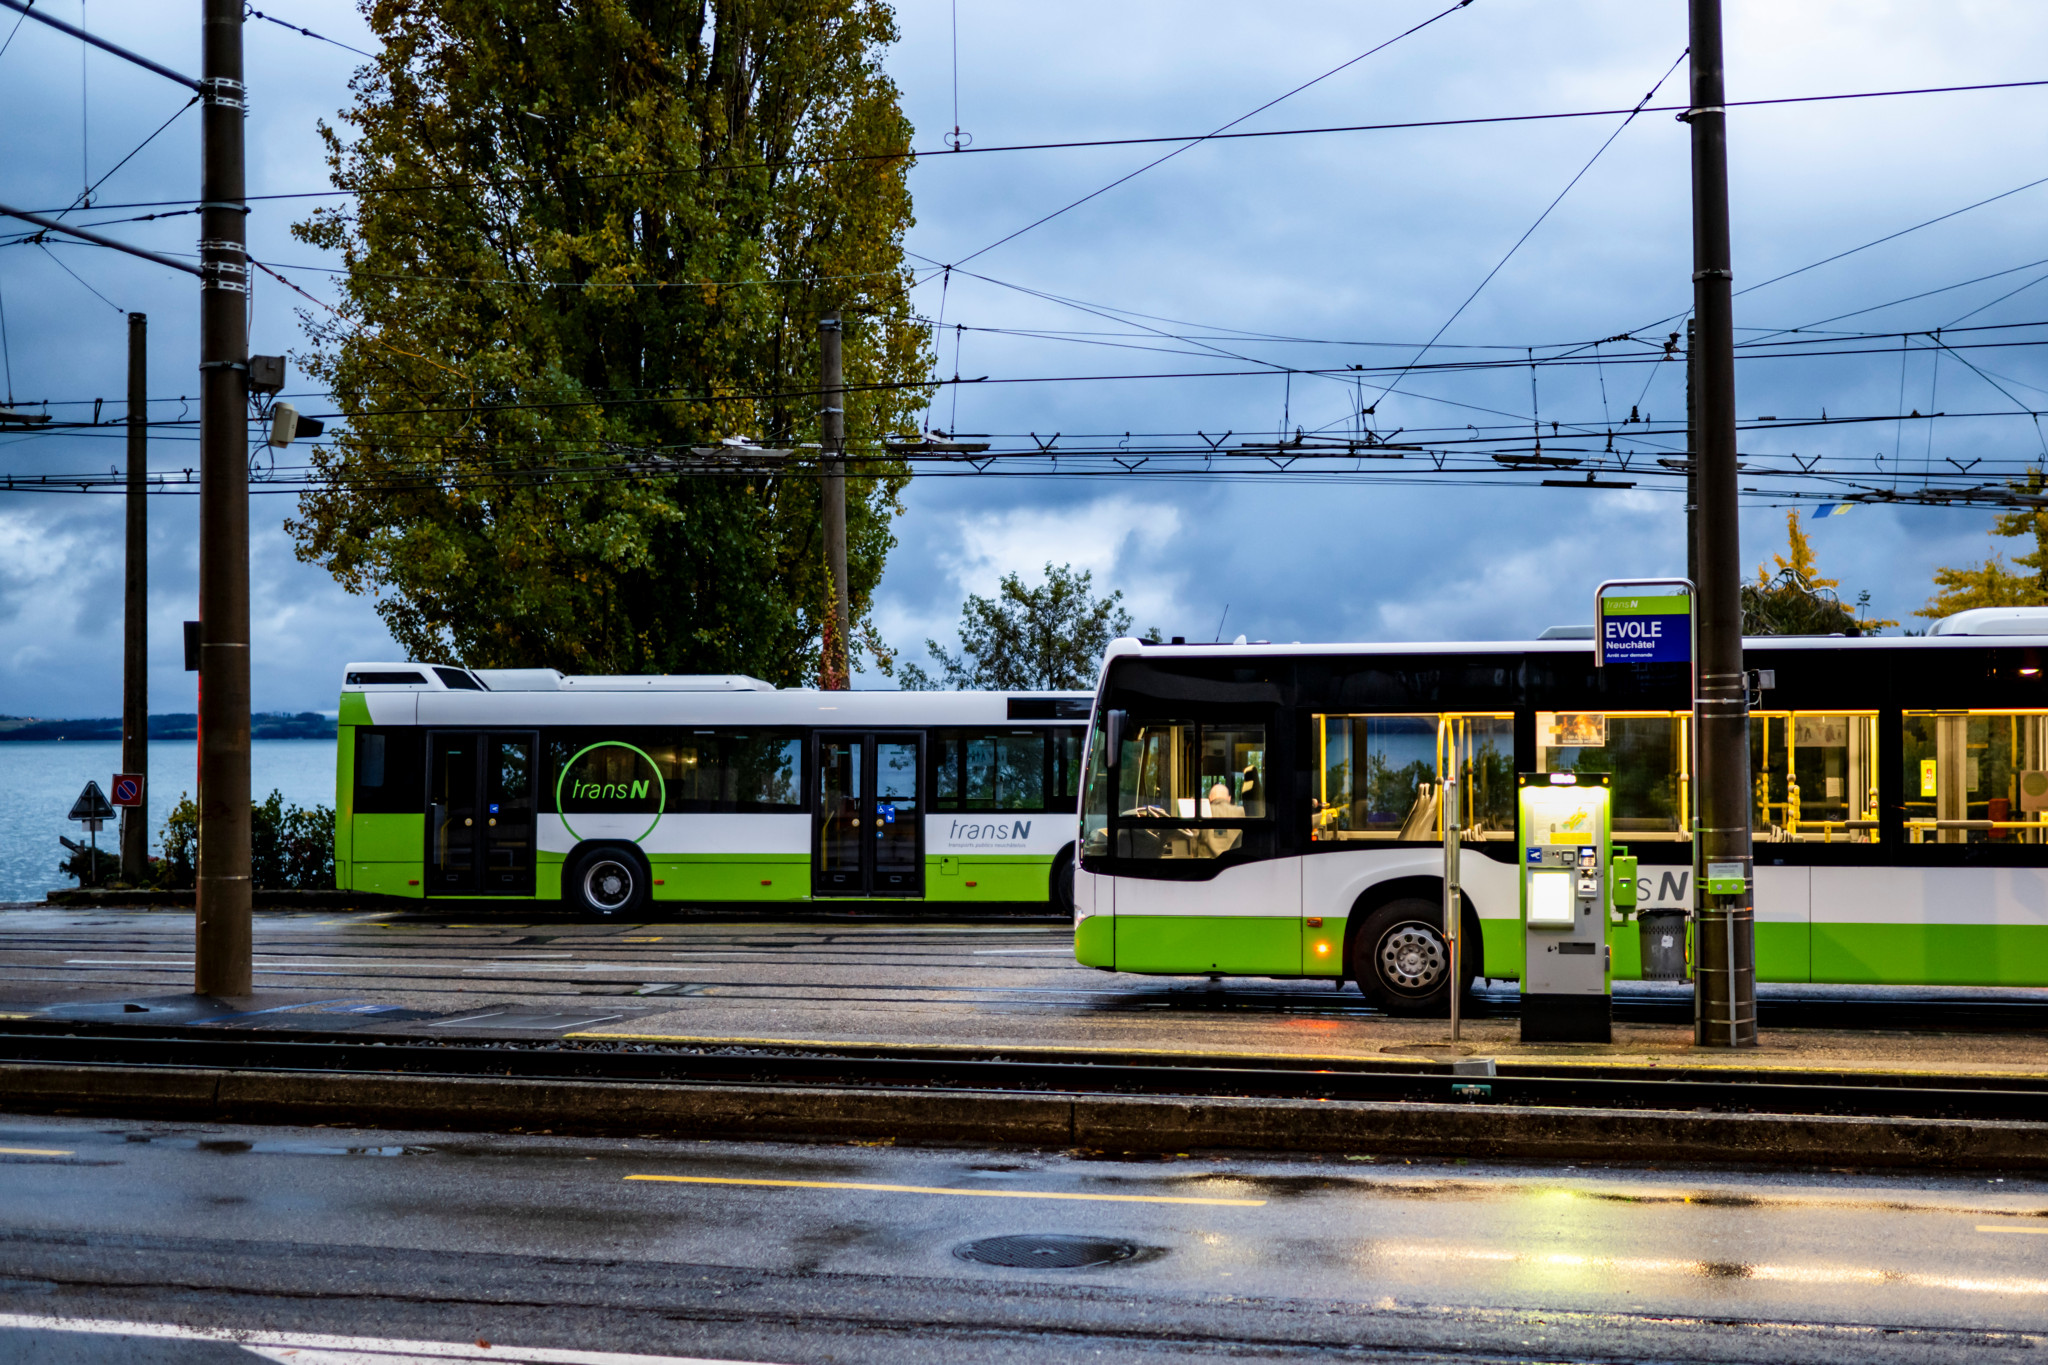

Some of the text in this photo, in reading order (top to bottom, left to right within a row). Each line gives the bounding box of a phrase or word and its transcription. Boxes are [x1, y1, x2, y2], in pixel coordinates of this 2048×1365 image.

[1606, 600, 1639, 609] transN
[1605, 621, 1662, 639] EVOLE
[1605, 640, 1655, 649] Neuchâtel
[572, 779, 650, 799] transN
[949, 819, 1032, 840] transN
